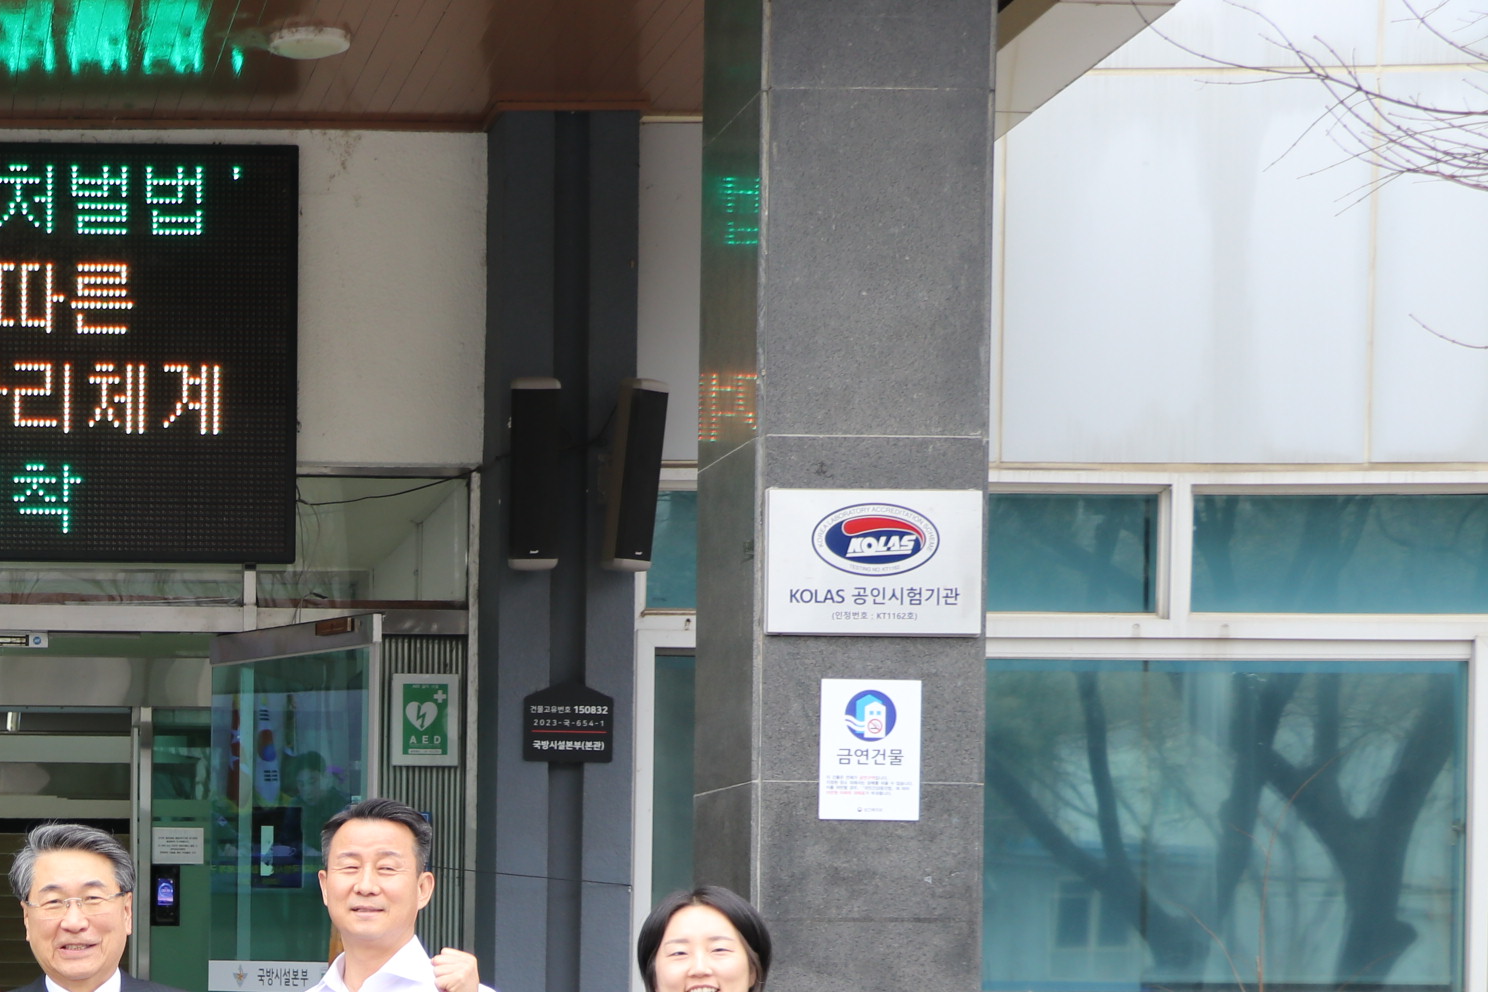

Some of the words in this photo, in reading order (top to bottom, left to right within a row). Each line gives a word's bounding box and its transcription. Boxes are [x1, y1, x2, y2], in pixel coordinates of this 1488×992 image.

[846, 534, 918, 555] KOLAS
[789, 588, 845, 604] KOLAS
[851, 586, 961, 606] 공인시험기관
[530, 705, 572, 714] 건물고유번호
[573, 705, 609, 715] 150832
[533, 719, 605, 727] 2023-국-654-1
[532, 739, 605, 751] 국방시설본부(본관)
[836, 748, 904, 766] 금연건물
[257, 967, 309, 987] 국방시설본부
